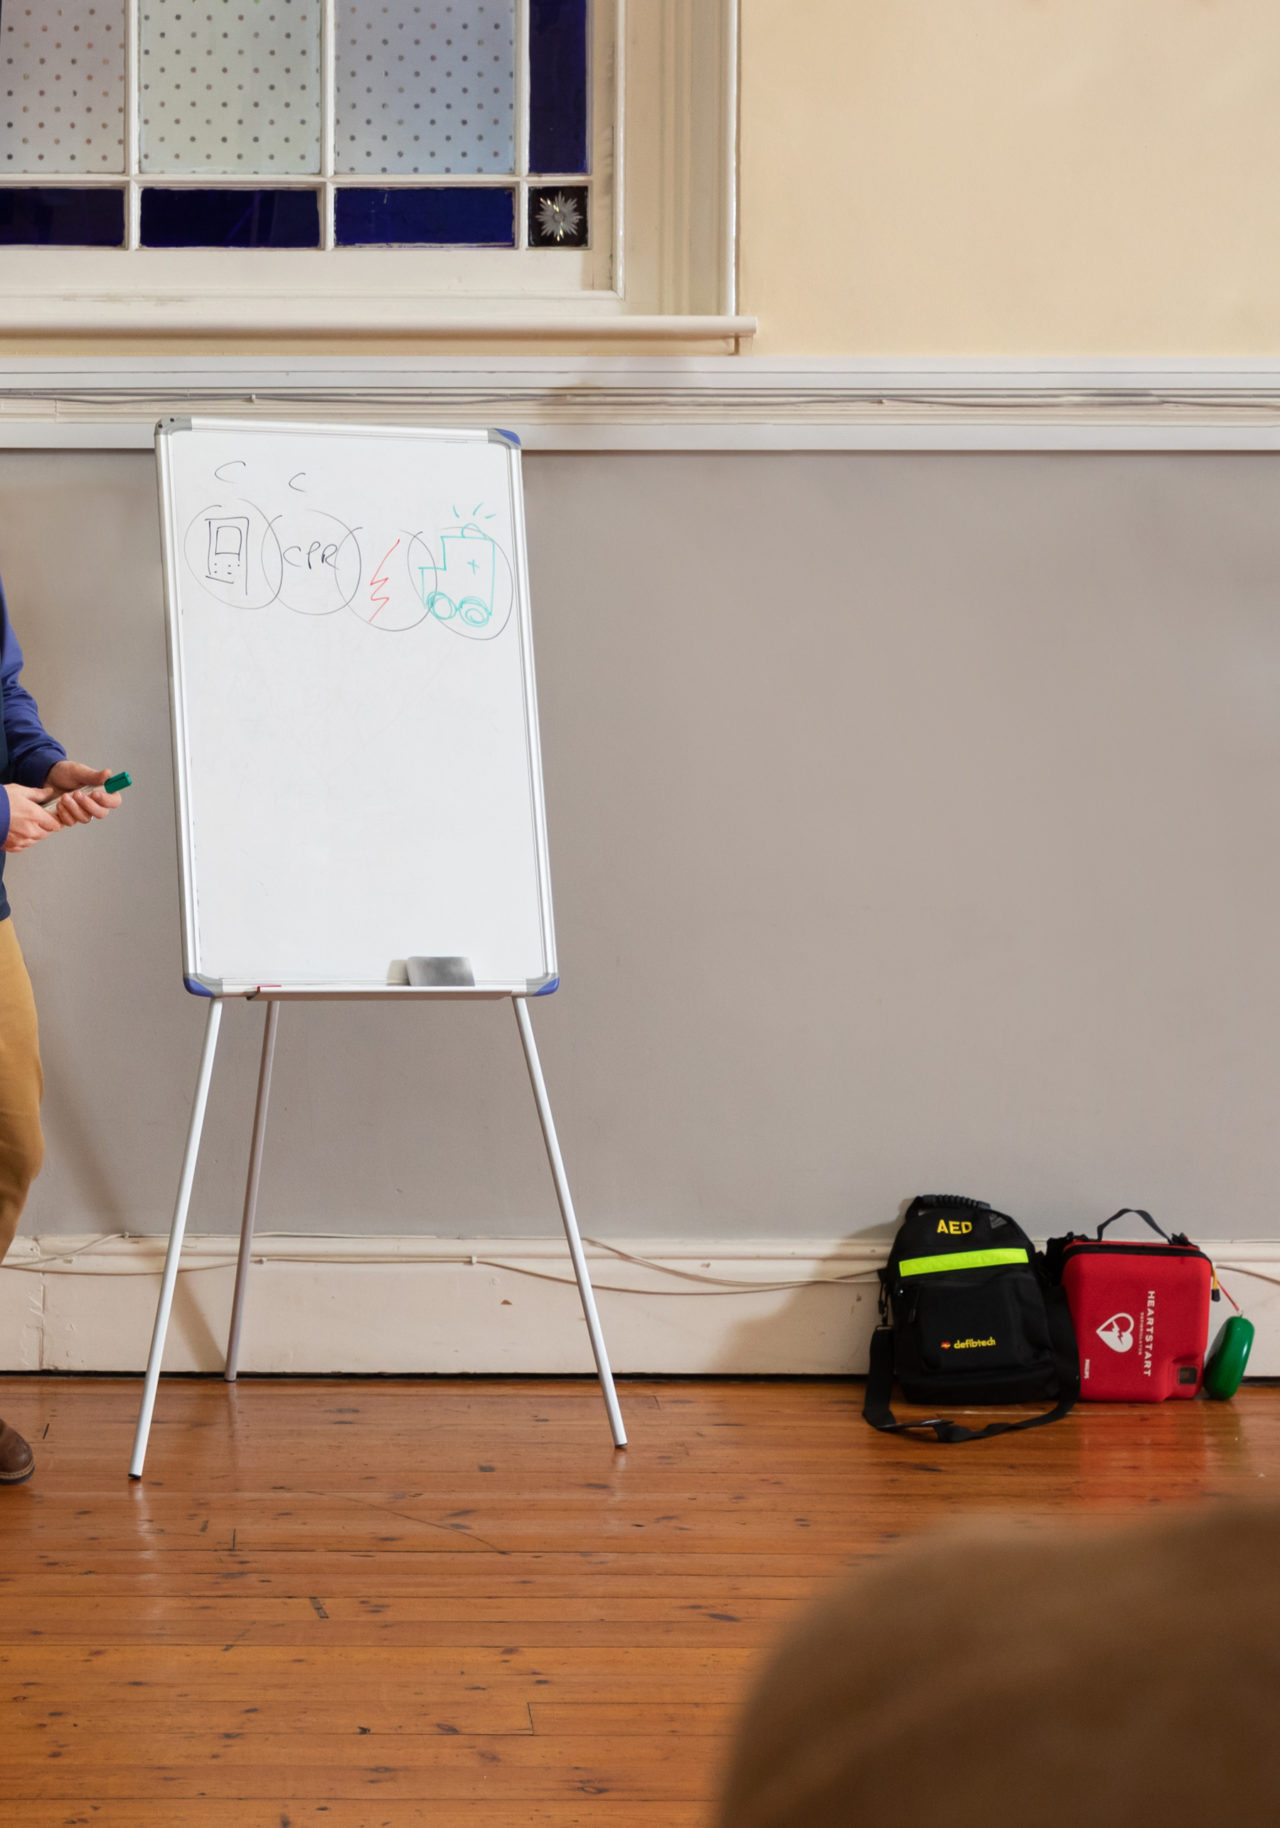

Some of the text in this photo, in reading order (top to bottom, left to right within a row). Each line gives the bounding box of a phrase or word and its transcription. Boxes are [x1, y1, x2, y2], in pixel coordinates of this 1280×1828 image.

[282, 541, 340, 570] CPR
[936, 1219, 973, 1235] AED
[953, 1336, 996, 1349] defibtech
[1144, 1290, 1156, 1377] HEARTSTART
